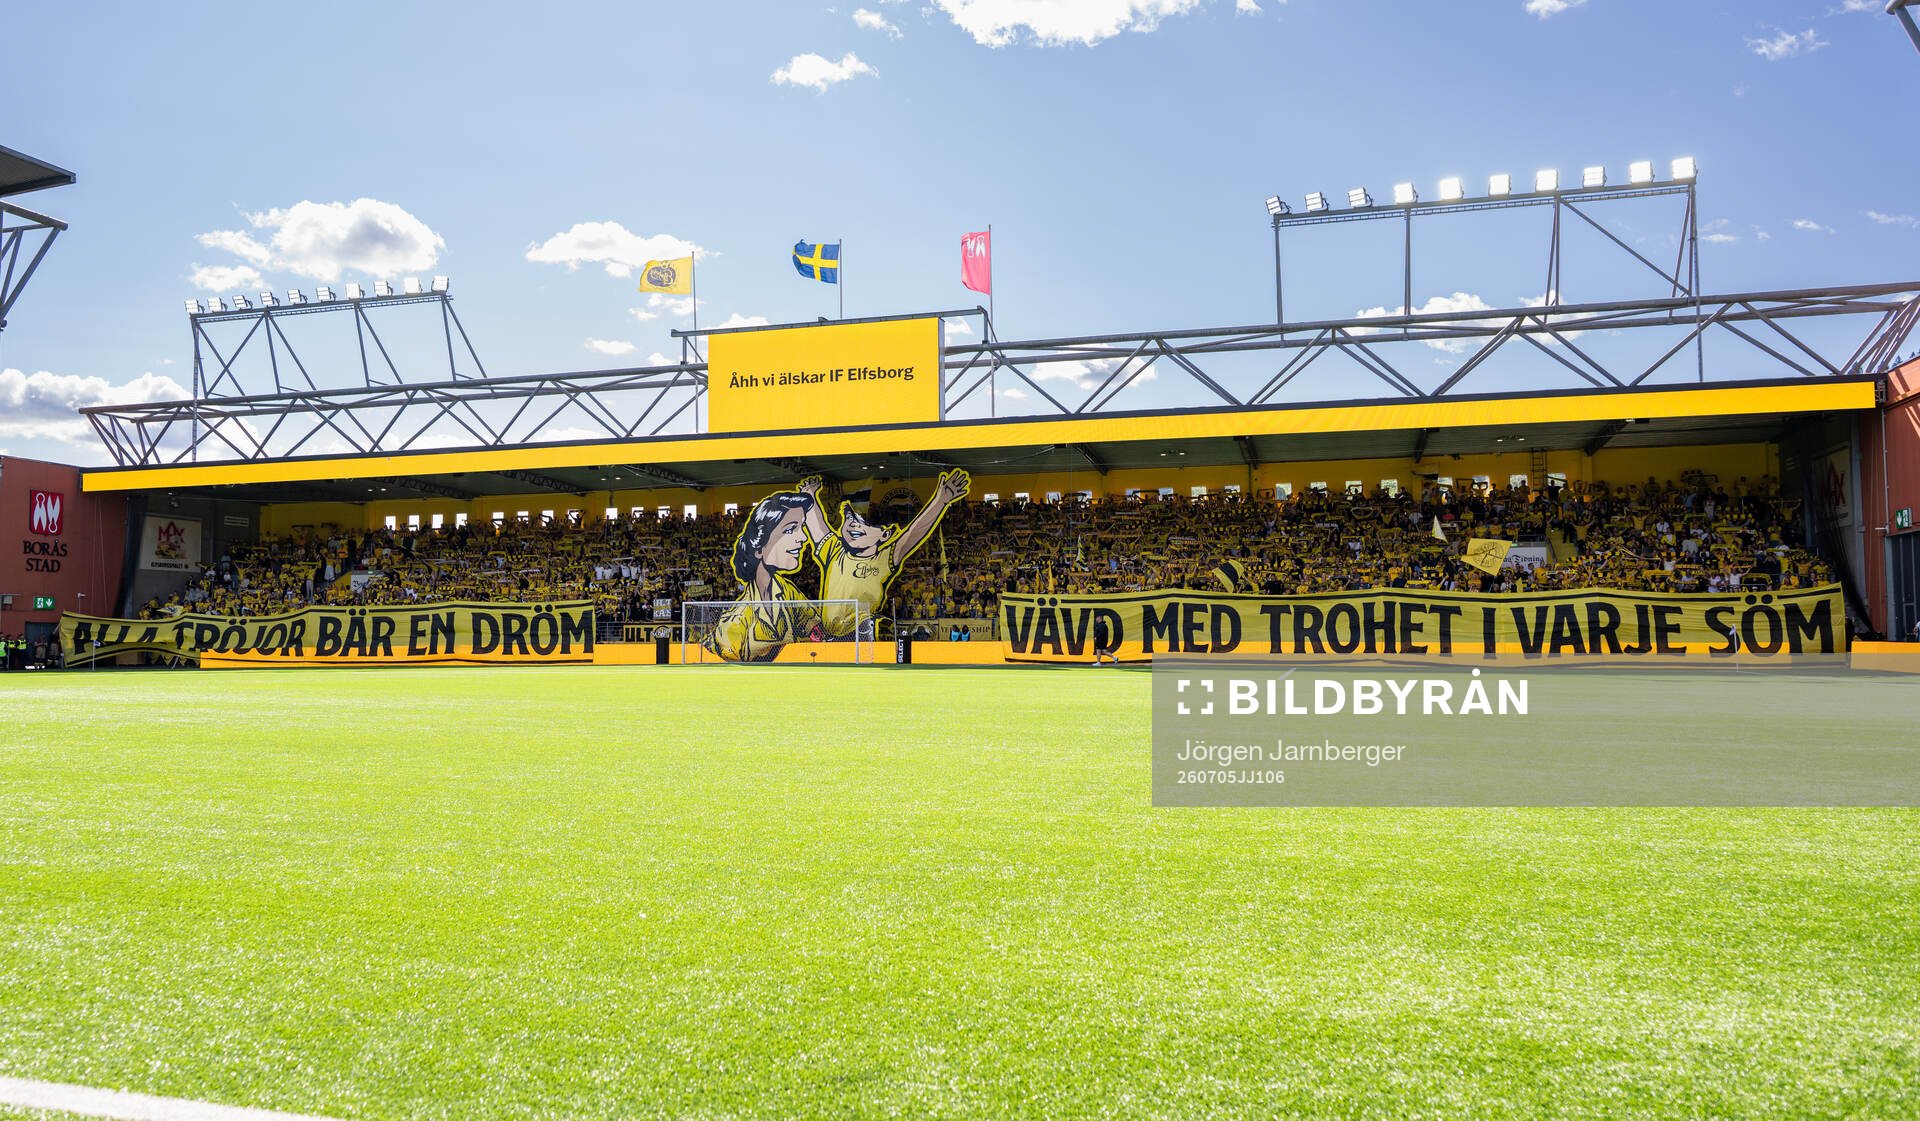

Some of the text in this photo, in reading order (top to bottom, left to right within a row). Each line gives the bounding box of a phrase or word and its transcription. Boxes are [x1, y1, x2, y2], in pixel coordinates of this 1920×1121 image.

[729, 366, 914, 389] Åhh vi älskar IF Elfsborg
[22, 539, 68, 557] BORÅS
[25, 557, 61, 573] STAD
[172, 618, 306, 657] TRÖJOR
[315, 608, 396, 657] BÄR
[407, 612, 456, 656] EN
[471, 604, 594, 656] DRÖM
[1005, 594, 1835, 660] VÄVD MED TROHET I VARJE SÖM
